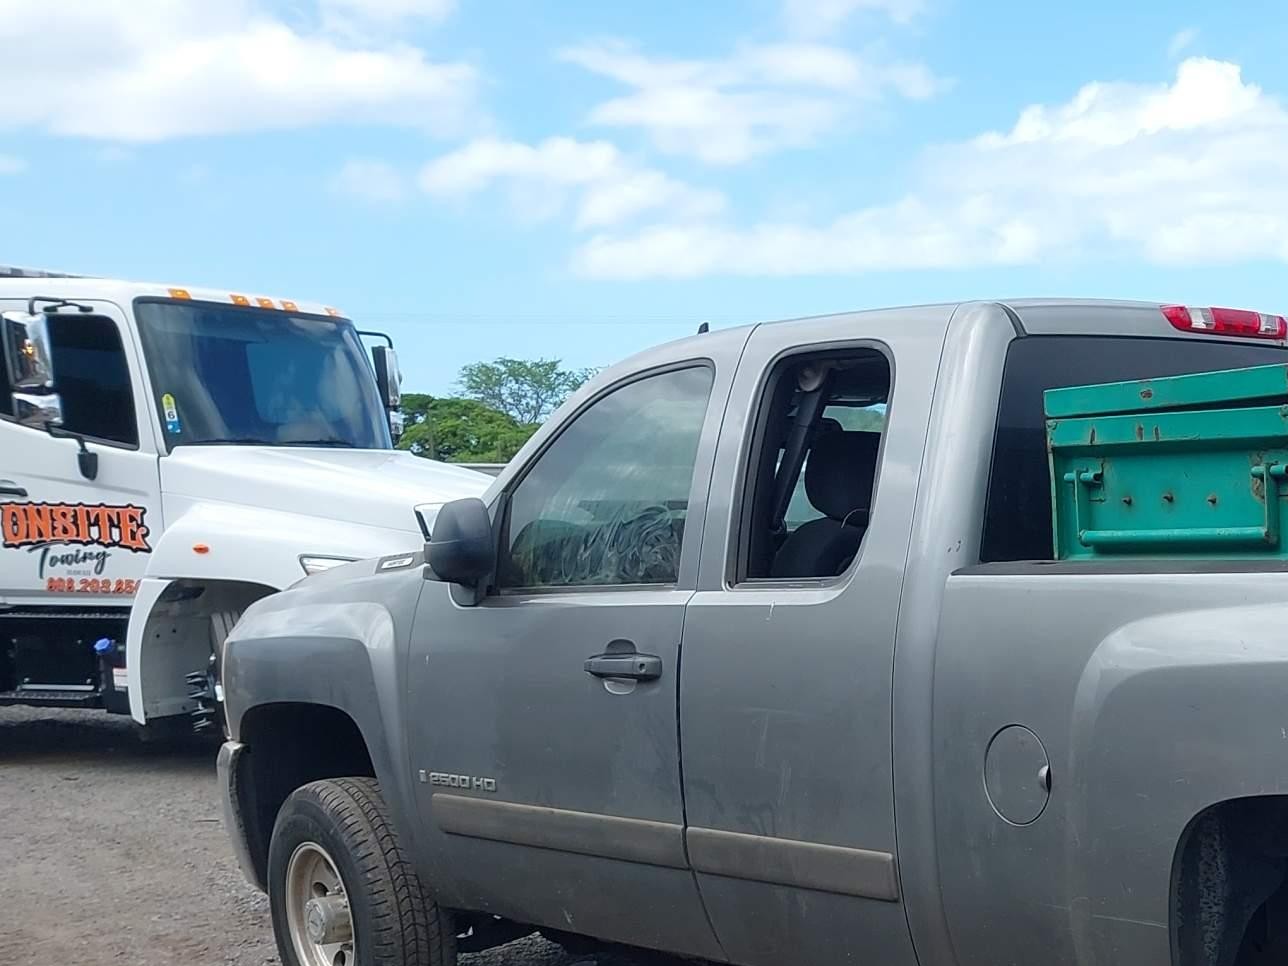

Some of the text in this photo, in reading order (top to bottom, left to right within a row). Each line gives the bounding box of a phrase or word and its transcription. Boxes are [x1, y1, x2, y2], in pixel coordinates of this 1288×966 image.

[0, 501, 152, 553] ONSITE
[27, 539, 111, 579] Towing
[429, 771, 497, 793] 2500 HD
